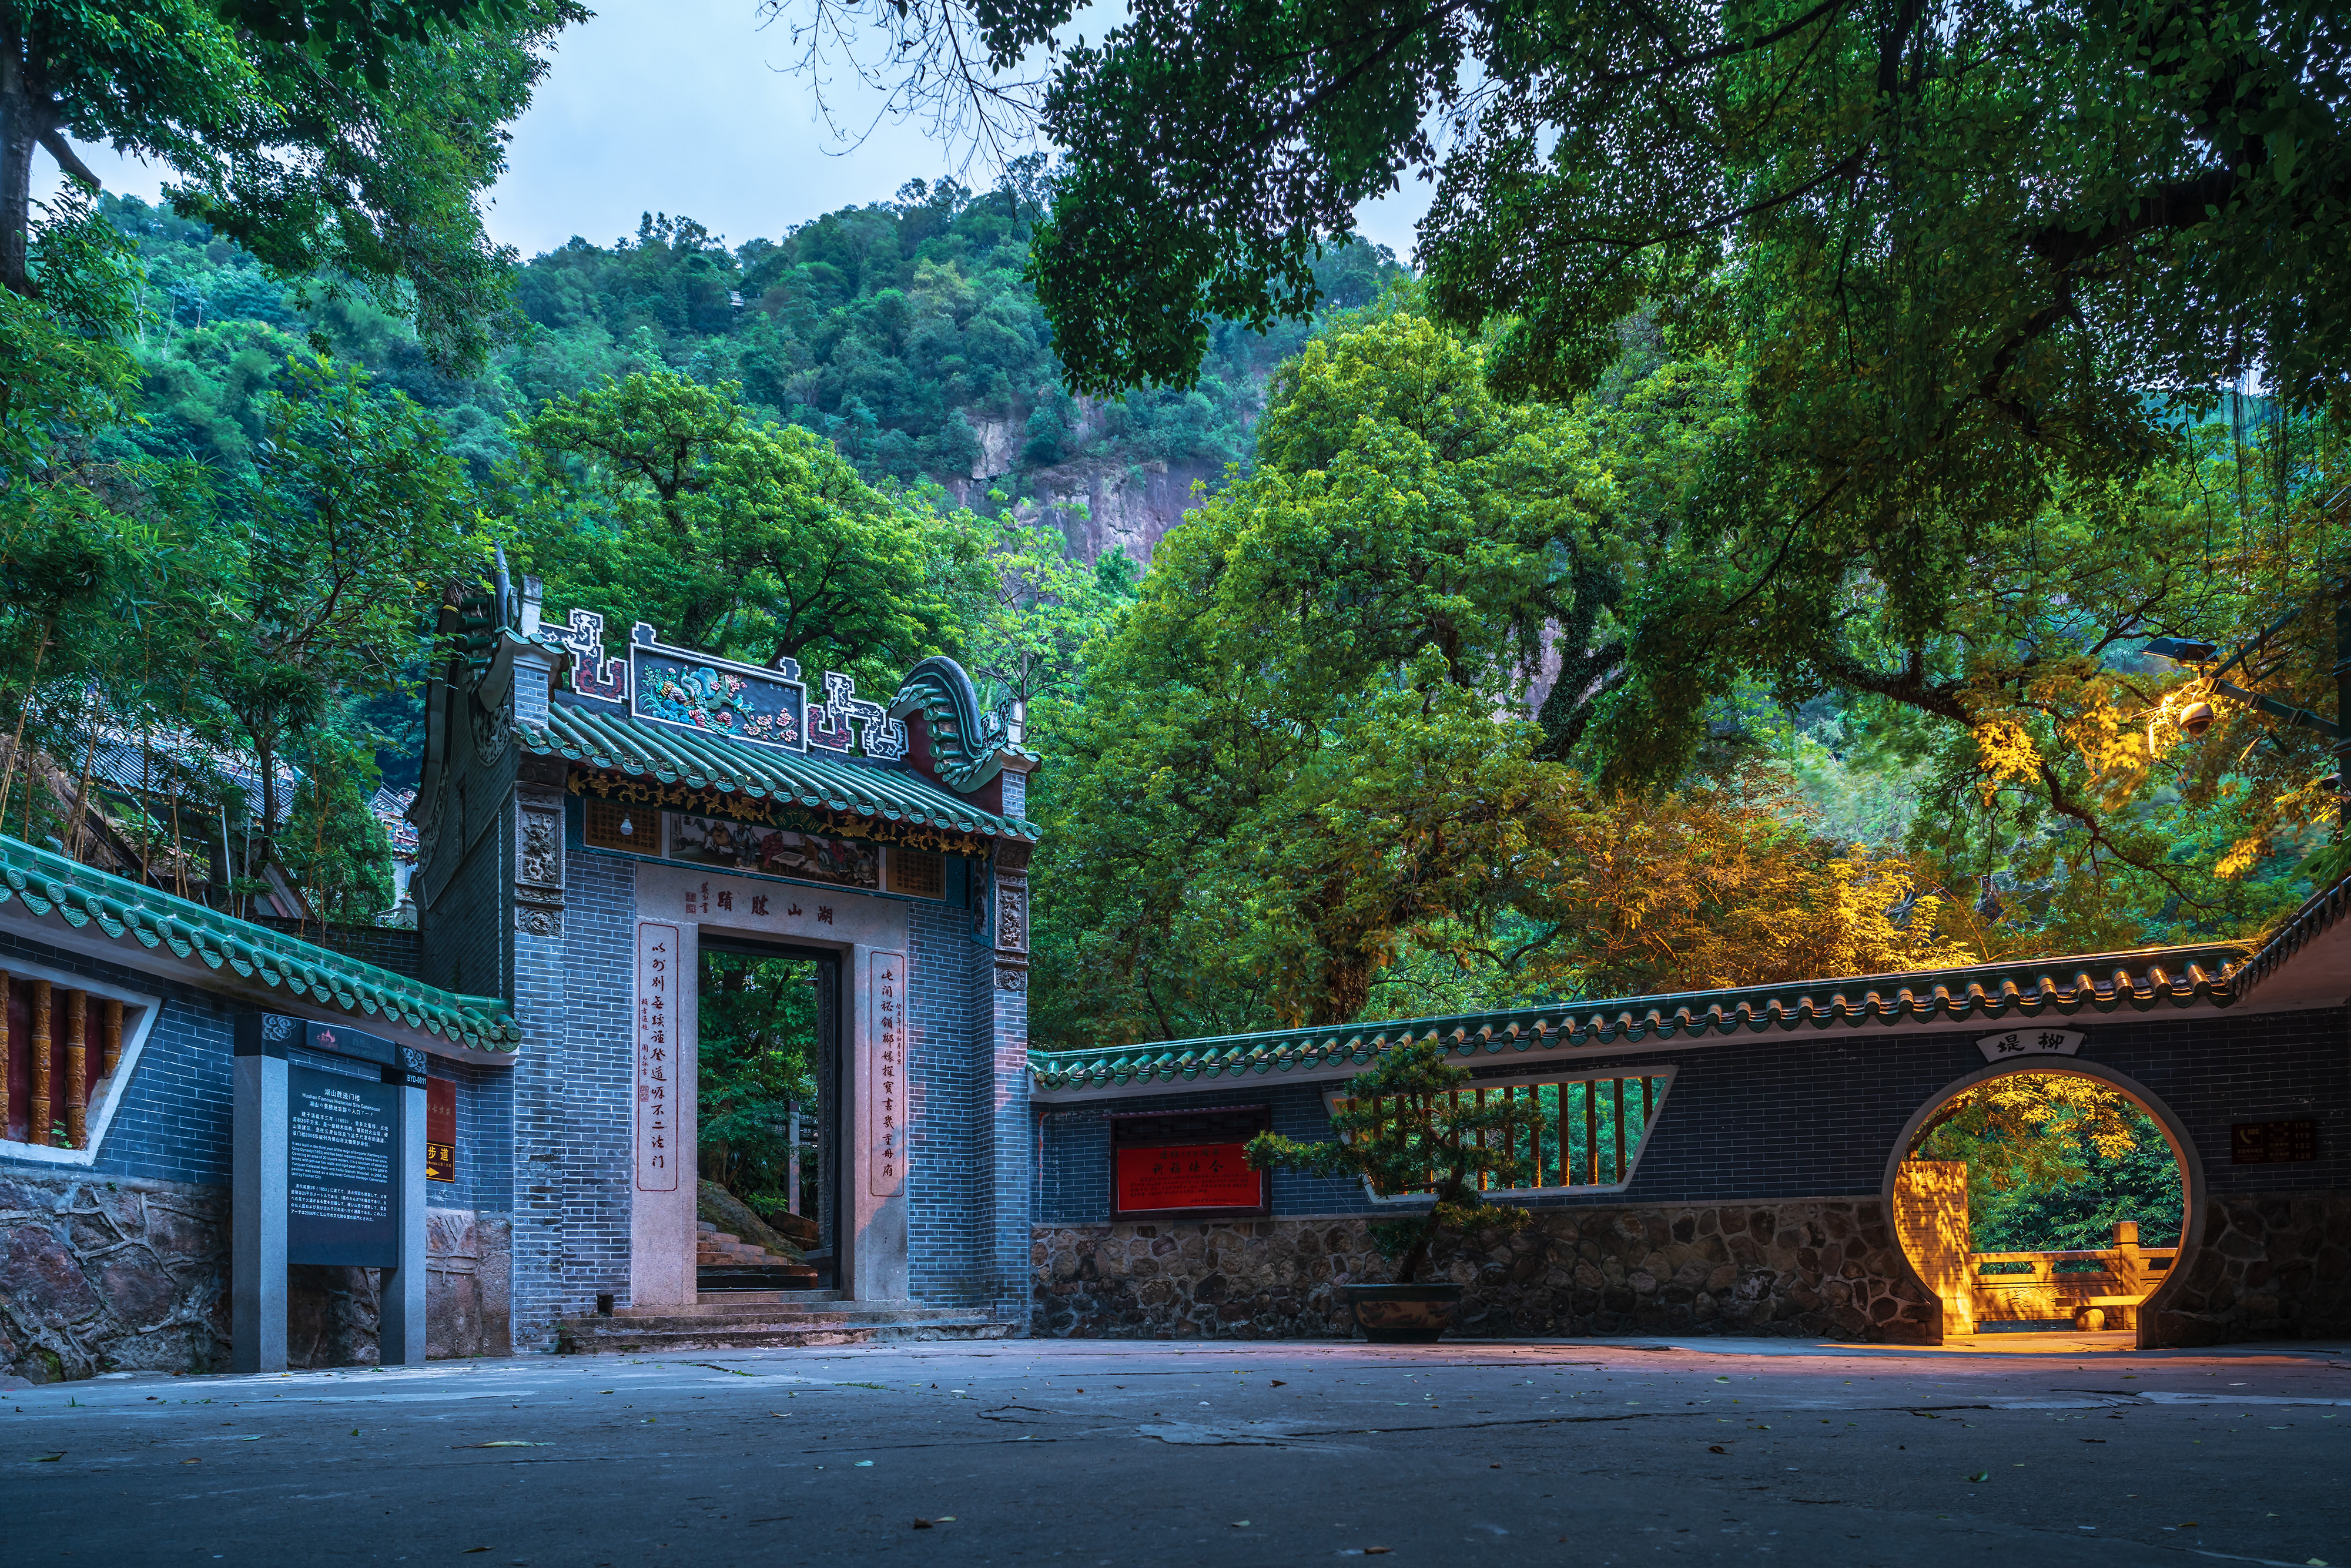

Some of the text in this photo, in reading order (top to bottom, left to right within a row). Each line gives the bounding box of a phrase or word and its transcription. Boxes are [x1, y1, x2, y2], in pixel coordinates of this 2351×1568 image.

[324, 1088, 360, 1102] 湖山胜迹门楼
[428, 1145, 448, 1161] 步道
